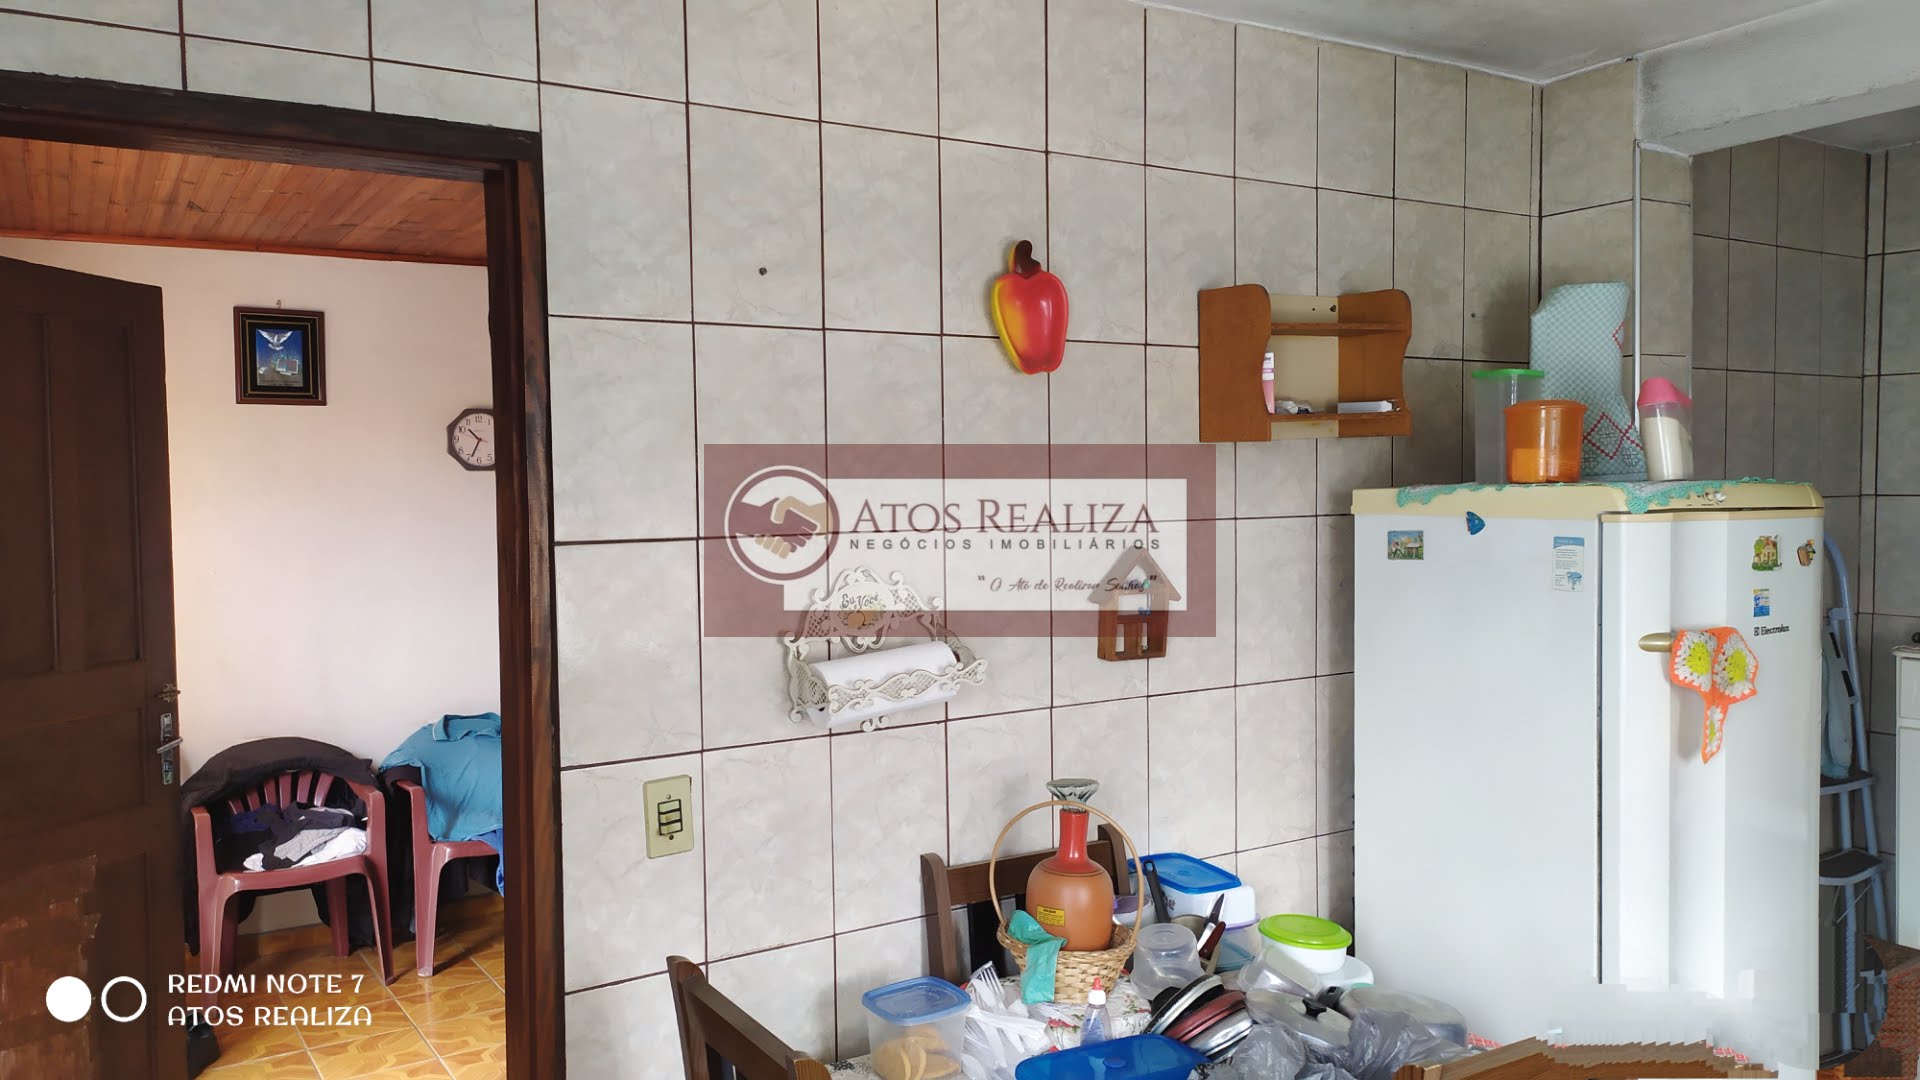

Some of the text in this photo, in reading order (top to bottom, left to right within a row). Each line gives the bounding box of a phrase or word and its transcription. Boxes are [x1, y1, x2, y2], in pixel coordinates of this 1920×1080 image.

[453, 435, 459, 443] 9
[458, 446, 464, 454] 8
[487, 453, 493, 461] 5
